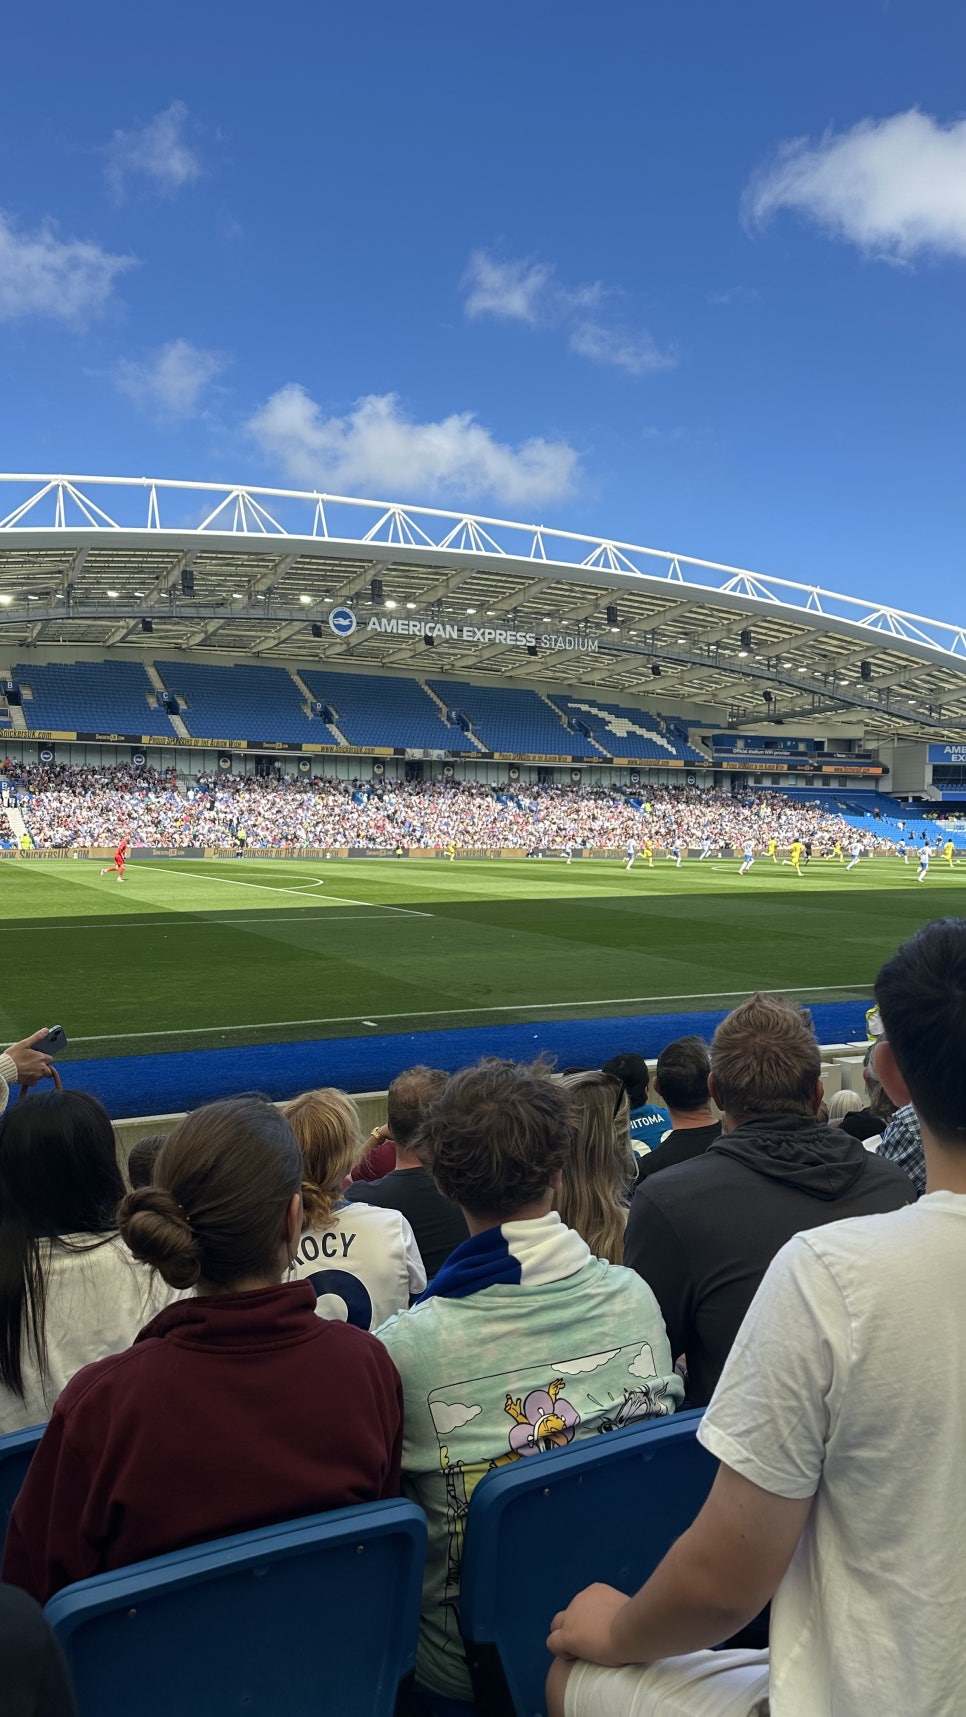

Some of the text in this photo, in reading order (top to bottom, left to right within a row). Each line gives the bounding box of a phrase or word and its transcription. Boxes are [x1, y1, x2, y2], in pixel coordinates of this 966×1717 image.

[367, 617, 457, 639] AMERICAN
[462, 627, 536, 647] EXPRESS
[541, 634, 599, 652] STADIUM
[7, 681, 13, 689] B
